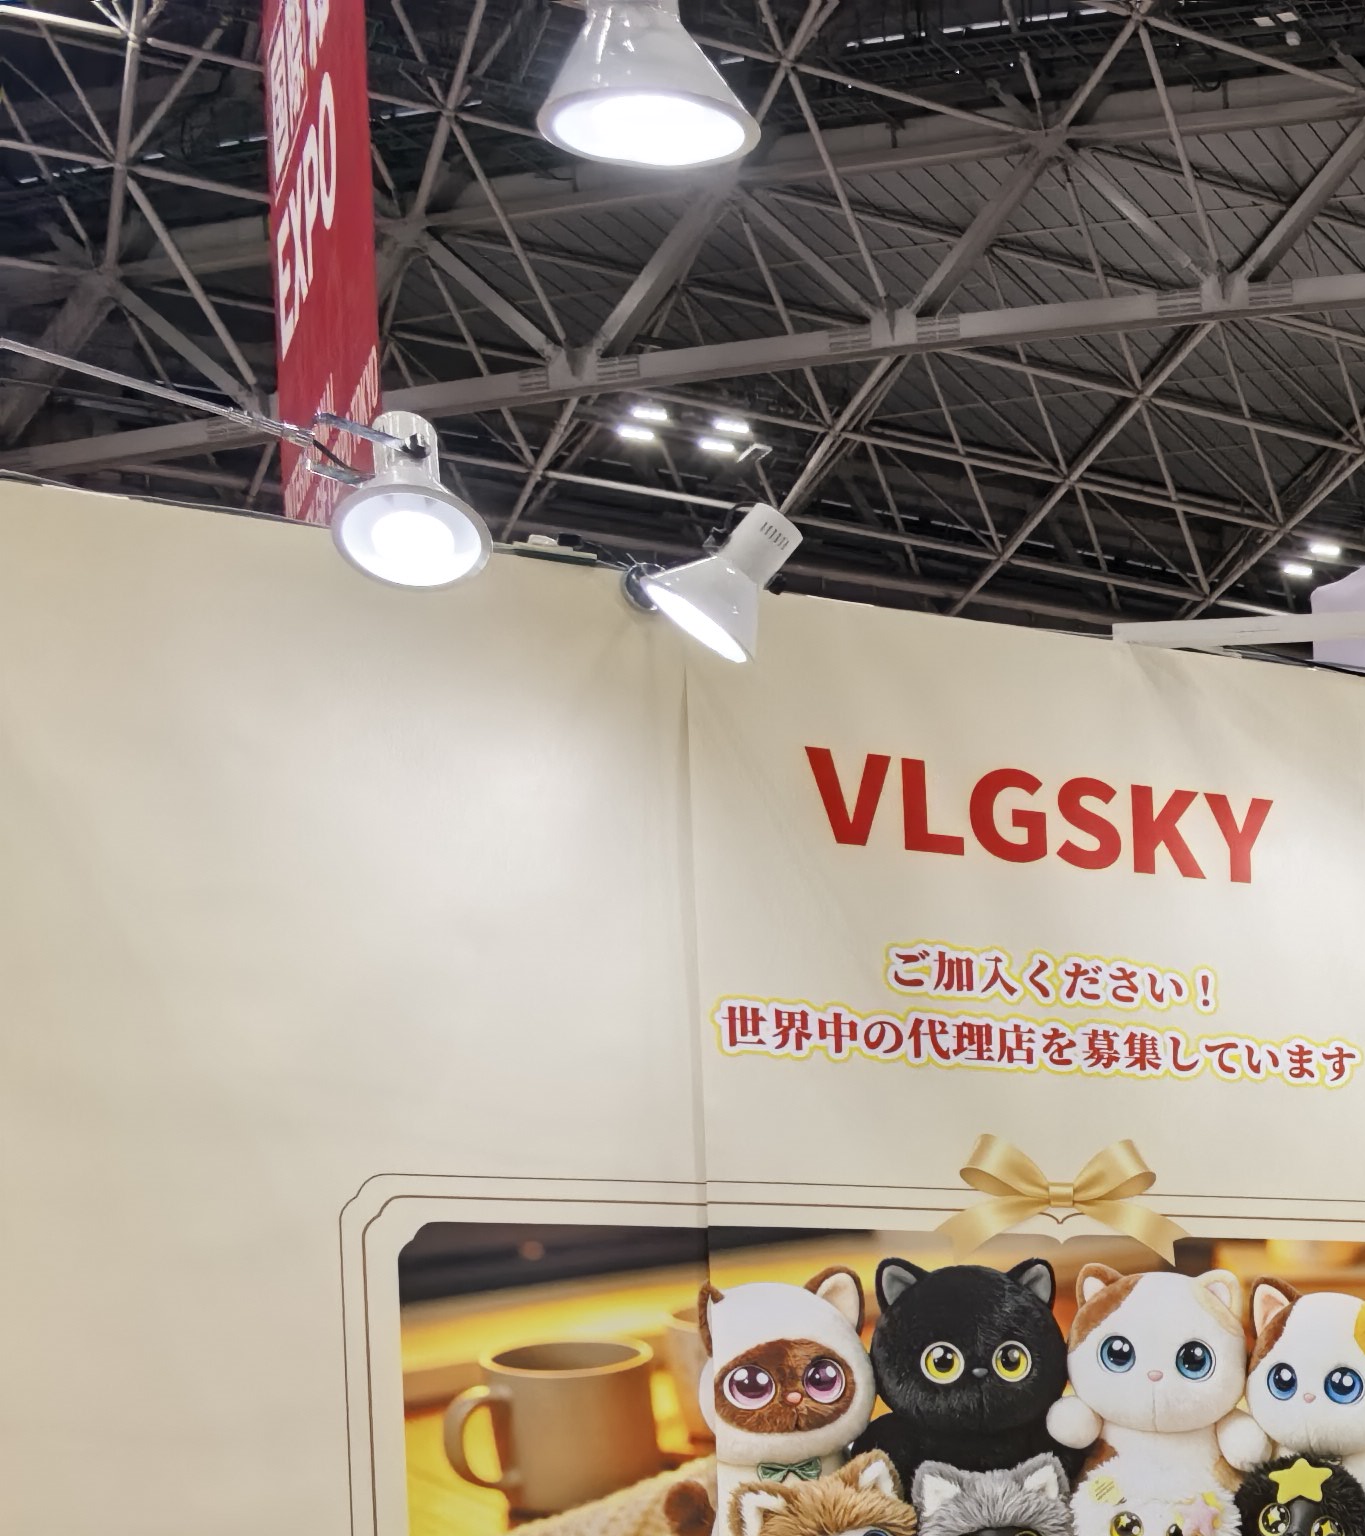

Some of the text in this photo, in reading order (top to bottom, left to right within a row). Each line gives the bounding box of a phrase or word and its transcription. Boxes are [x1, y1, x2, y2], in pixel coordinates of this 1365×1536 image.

[276, 71, 337, 361] EXPO
[804, 745, 1274, 884] VLGSKY
[721, 1004, 1361, 1083] 世界中の代理店を募集しています
